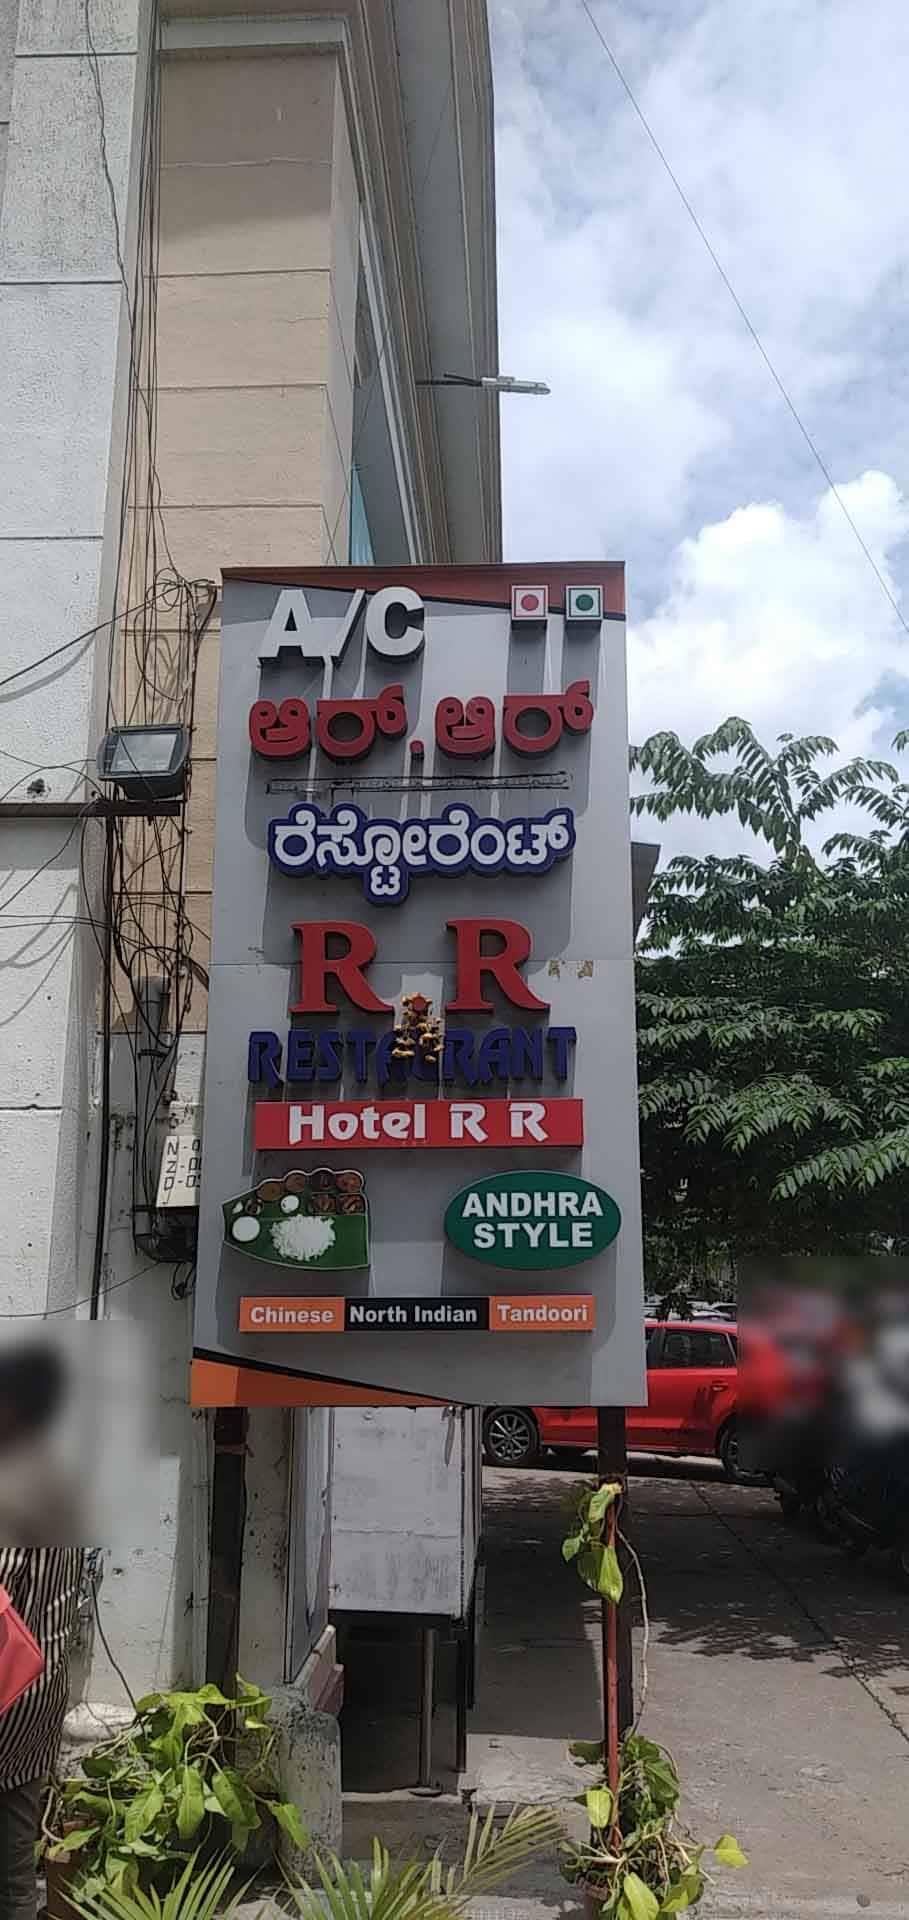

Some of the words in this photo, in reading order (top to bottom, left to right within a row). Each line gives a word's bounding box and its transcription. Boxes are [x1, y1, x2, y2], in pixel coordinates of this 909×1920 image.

[259, 586, 425, 657] A/C
[272, 808, 571, 897] ರೆಸ್ಟೋರೆಂಟ್
[289, 920, 395, 1013] R
[446, 917, 551, 1012] R
[289, 1102, 426, 1145] Hotel
[450, 1103, 489, 1143] R
[509, 1103, 549, 1142] R
[462, 1191, 604, 1218] ANDHRA
[473, 1222, 594, 1248] STYLE
[250, 1306, 335, 1324] Chinese
[350, 1306, 408, 1324] North
[414, 1305, 478, 1323] Indian
[497, 1304, 588, 1322] Tandoori
